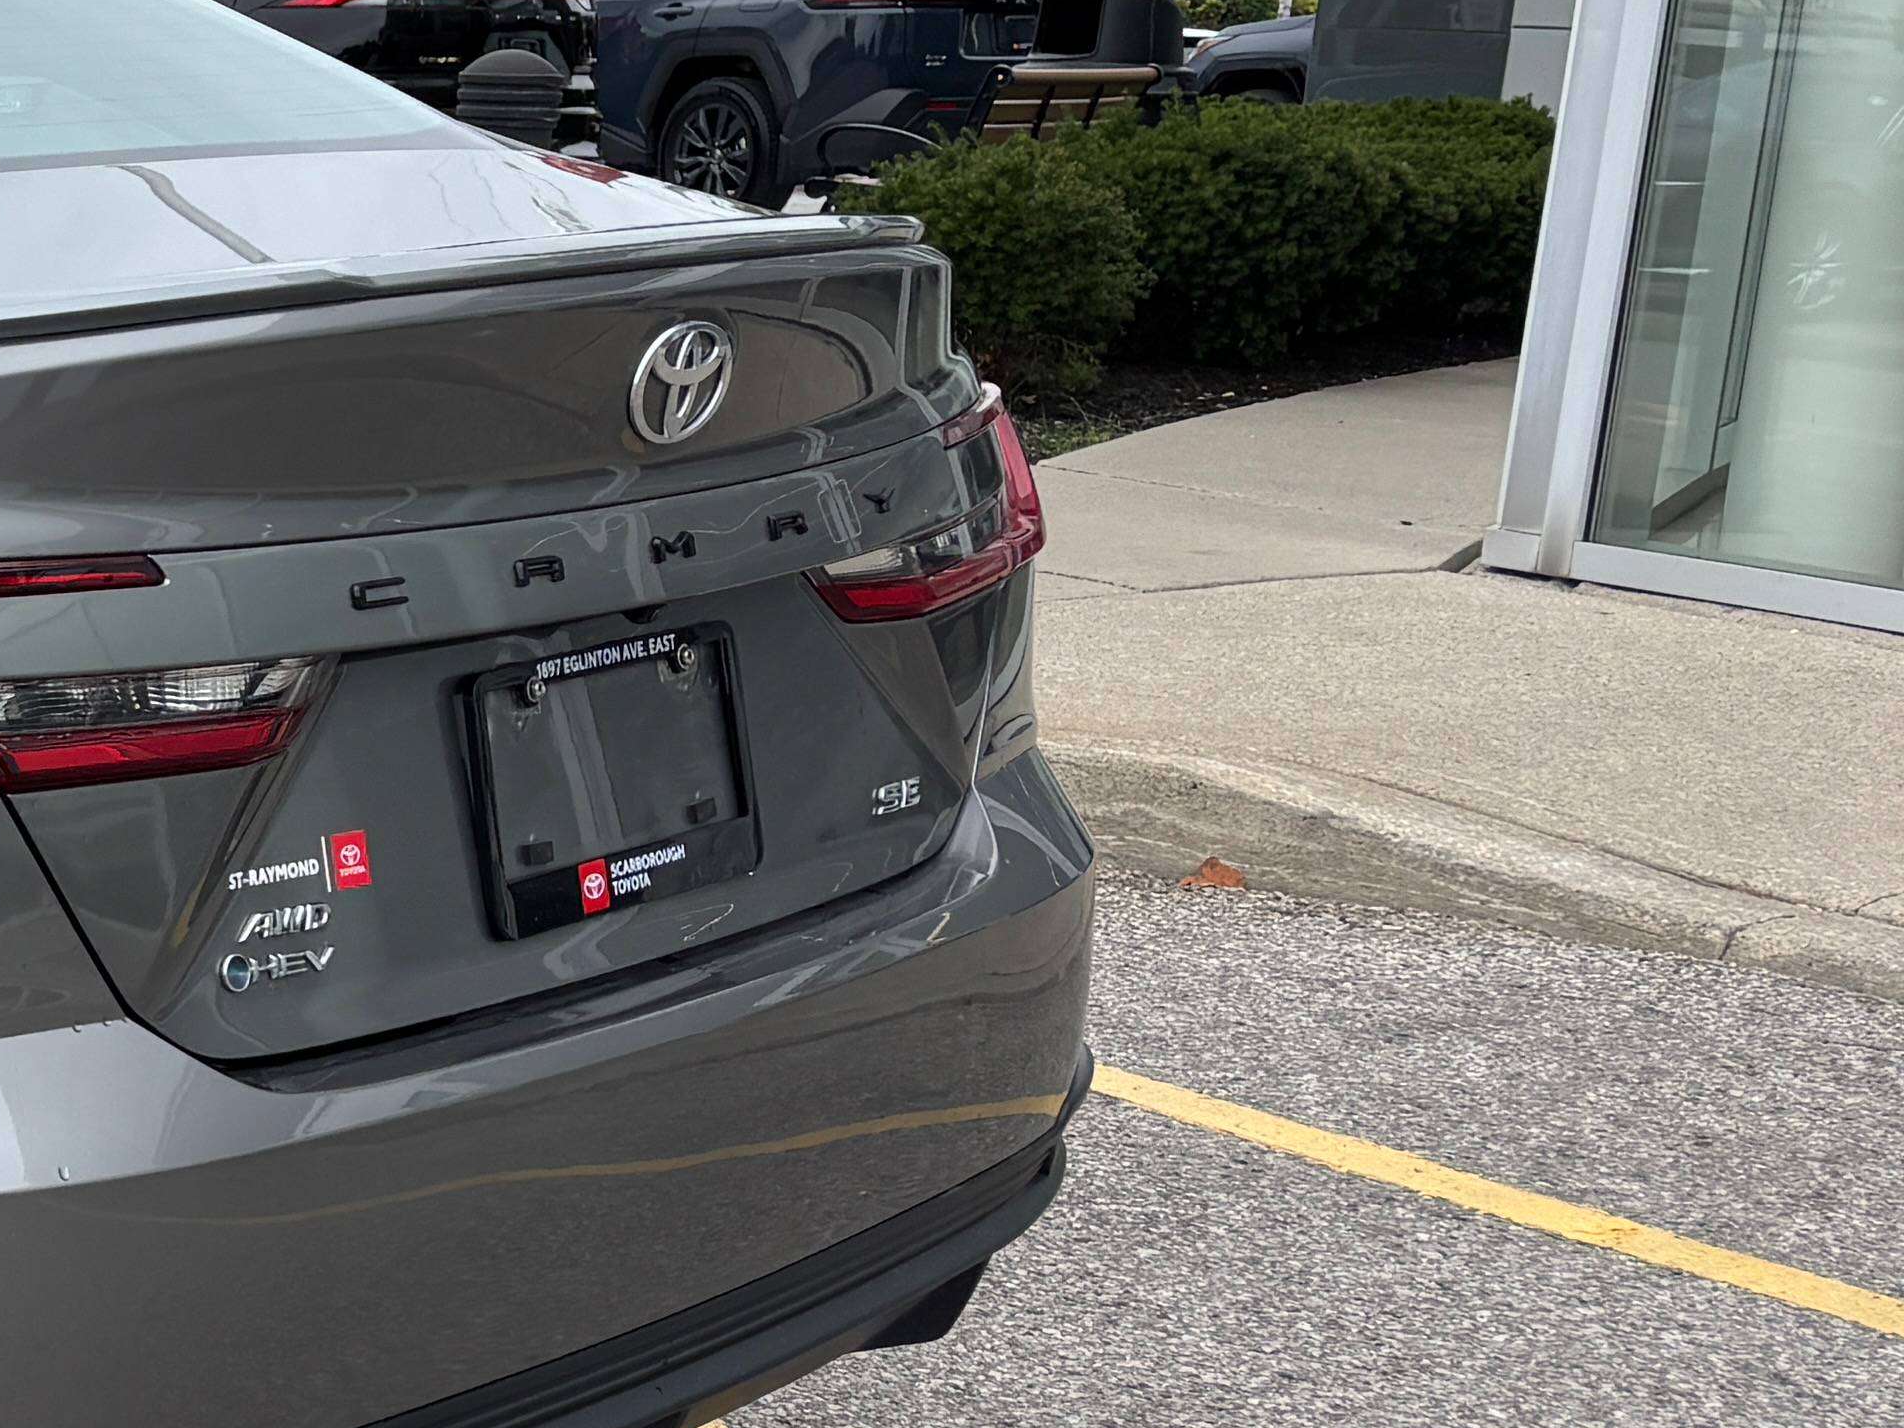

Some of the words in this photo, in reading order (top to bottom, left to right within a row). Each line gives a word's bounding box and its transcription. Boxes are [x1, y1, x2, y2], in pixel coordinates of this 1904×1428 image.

[349, 486, 895, 612] CAMRY
[563, 646, 621, 674] EGLINTON
[648, 633, 676, 655] EAST
[873, 775, 921, 816] SE
[227, 858, 320, 890] ST-RAYMOND
[610, 843, 686, 879] SCARBOROUGH
[611, 872, 652, 896] TOYOTA
[236, 903, 332, 943] AWD
